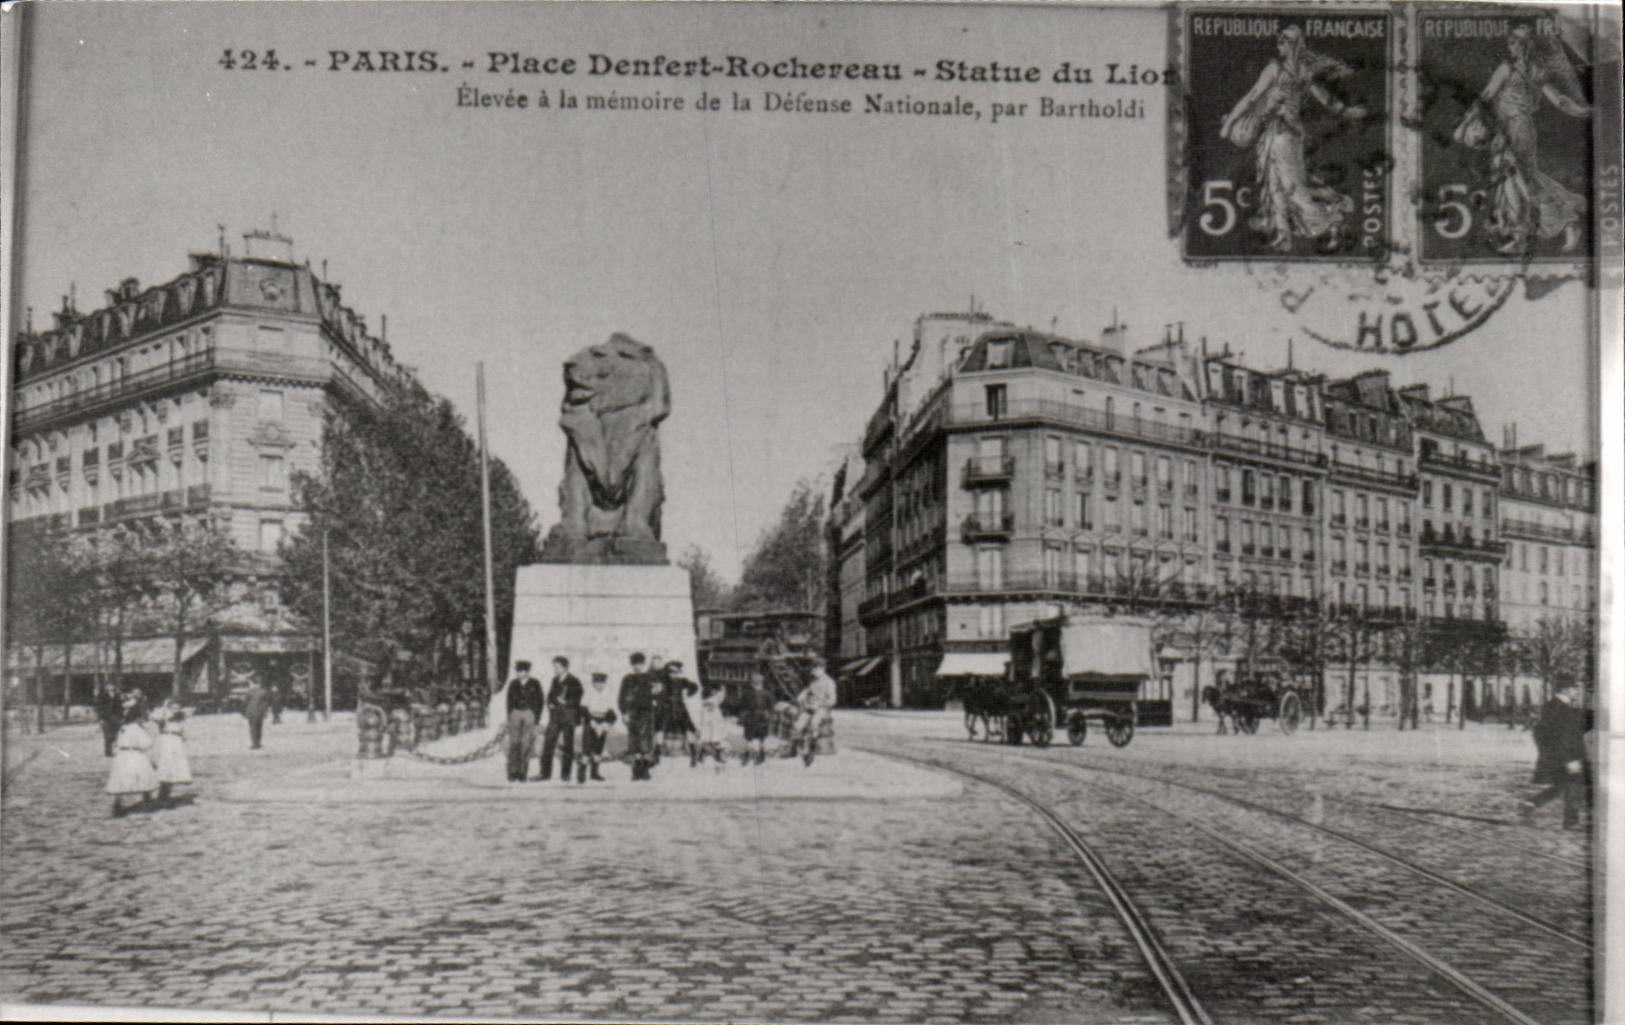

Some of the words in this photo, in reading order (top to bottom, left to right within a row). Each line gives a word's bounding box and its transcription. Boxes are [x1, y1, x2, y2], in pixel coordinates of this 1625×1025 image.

[1193, 17, 1281, 37] REPUBLIQUE
[1306, 19, 1385, 39] FRANÇAISE
[1362, 166, 1384, 248] POSTES
